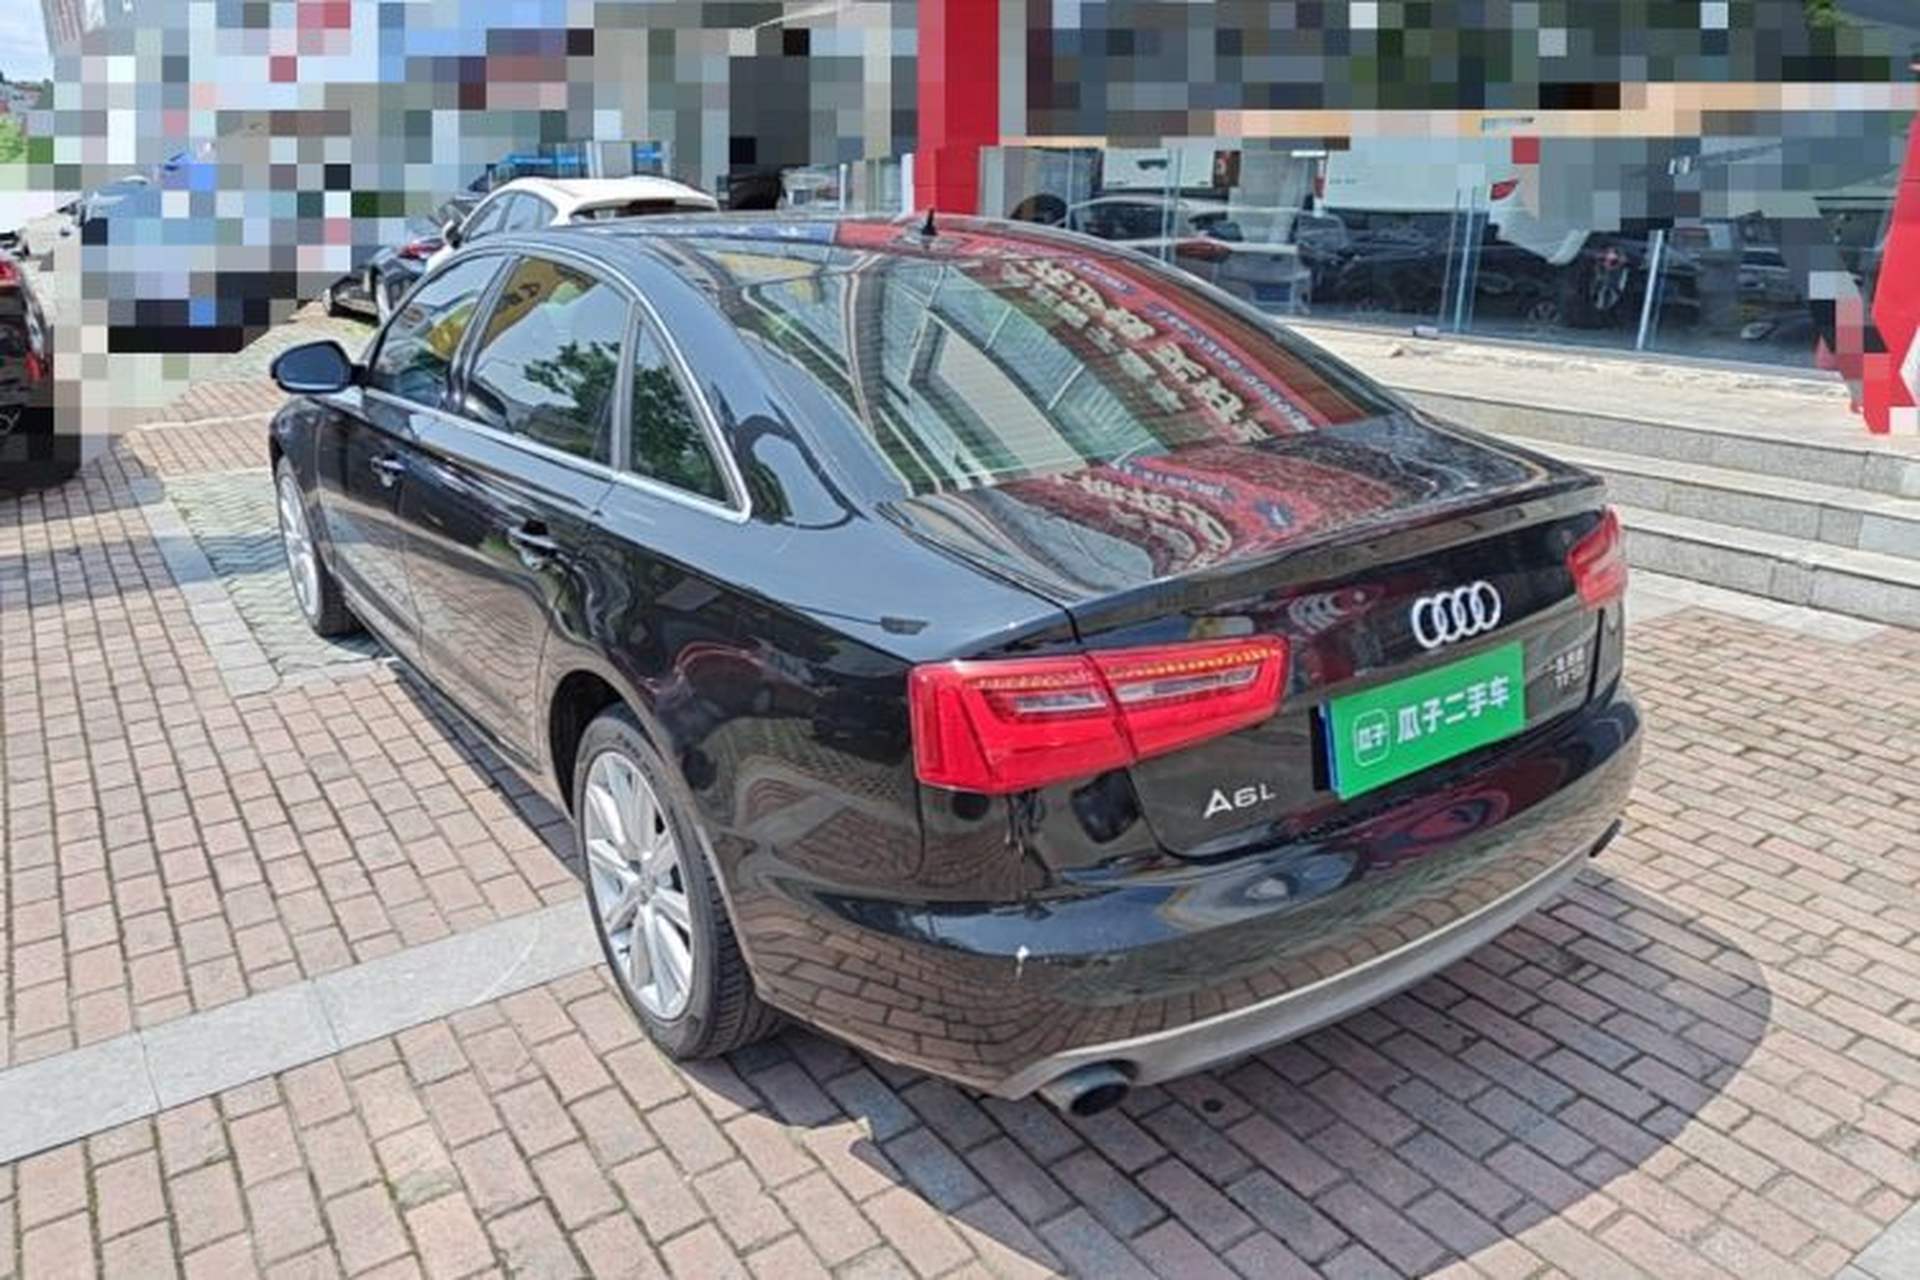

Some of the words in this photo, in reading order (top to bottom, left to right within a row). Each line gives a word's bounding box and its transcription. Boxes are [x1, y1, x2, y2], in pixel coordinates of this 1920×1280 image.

[1397, 675, 1509, 744] 瓜子二手车
[1203, 783, 1276, 819] A6L
